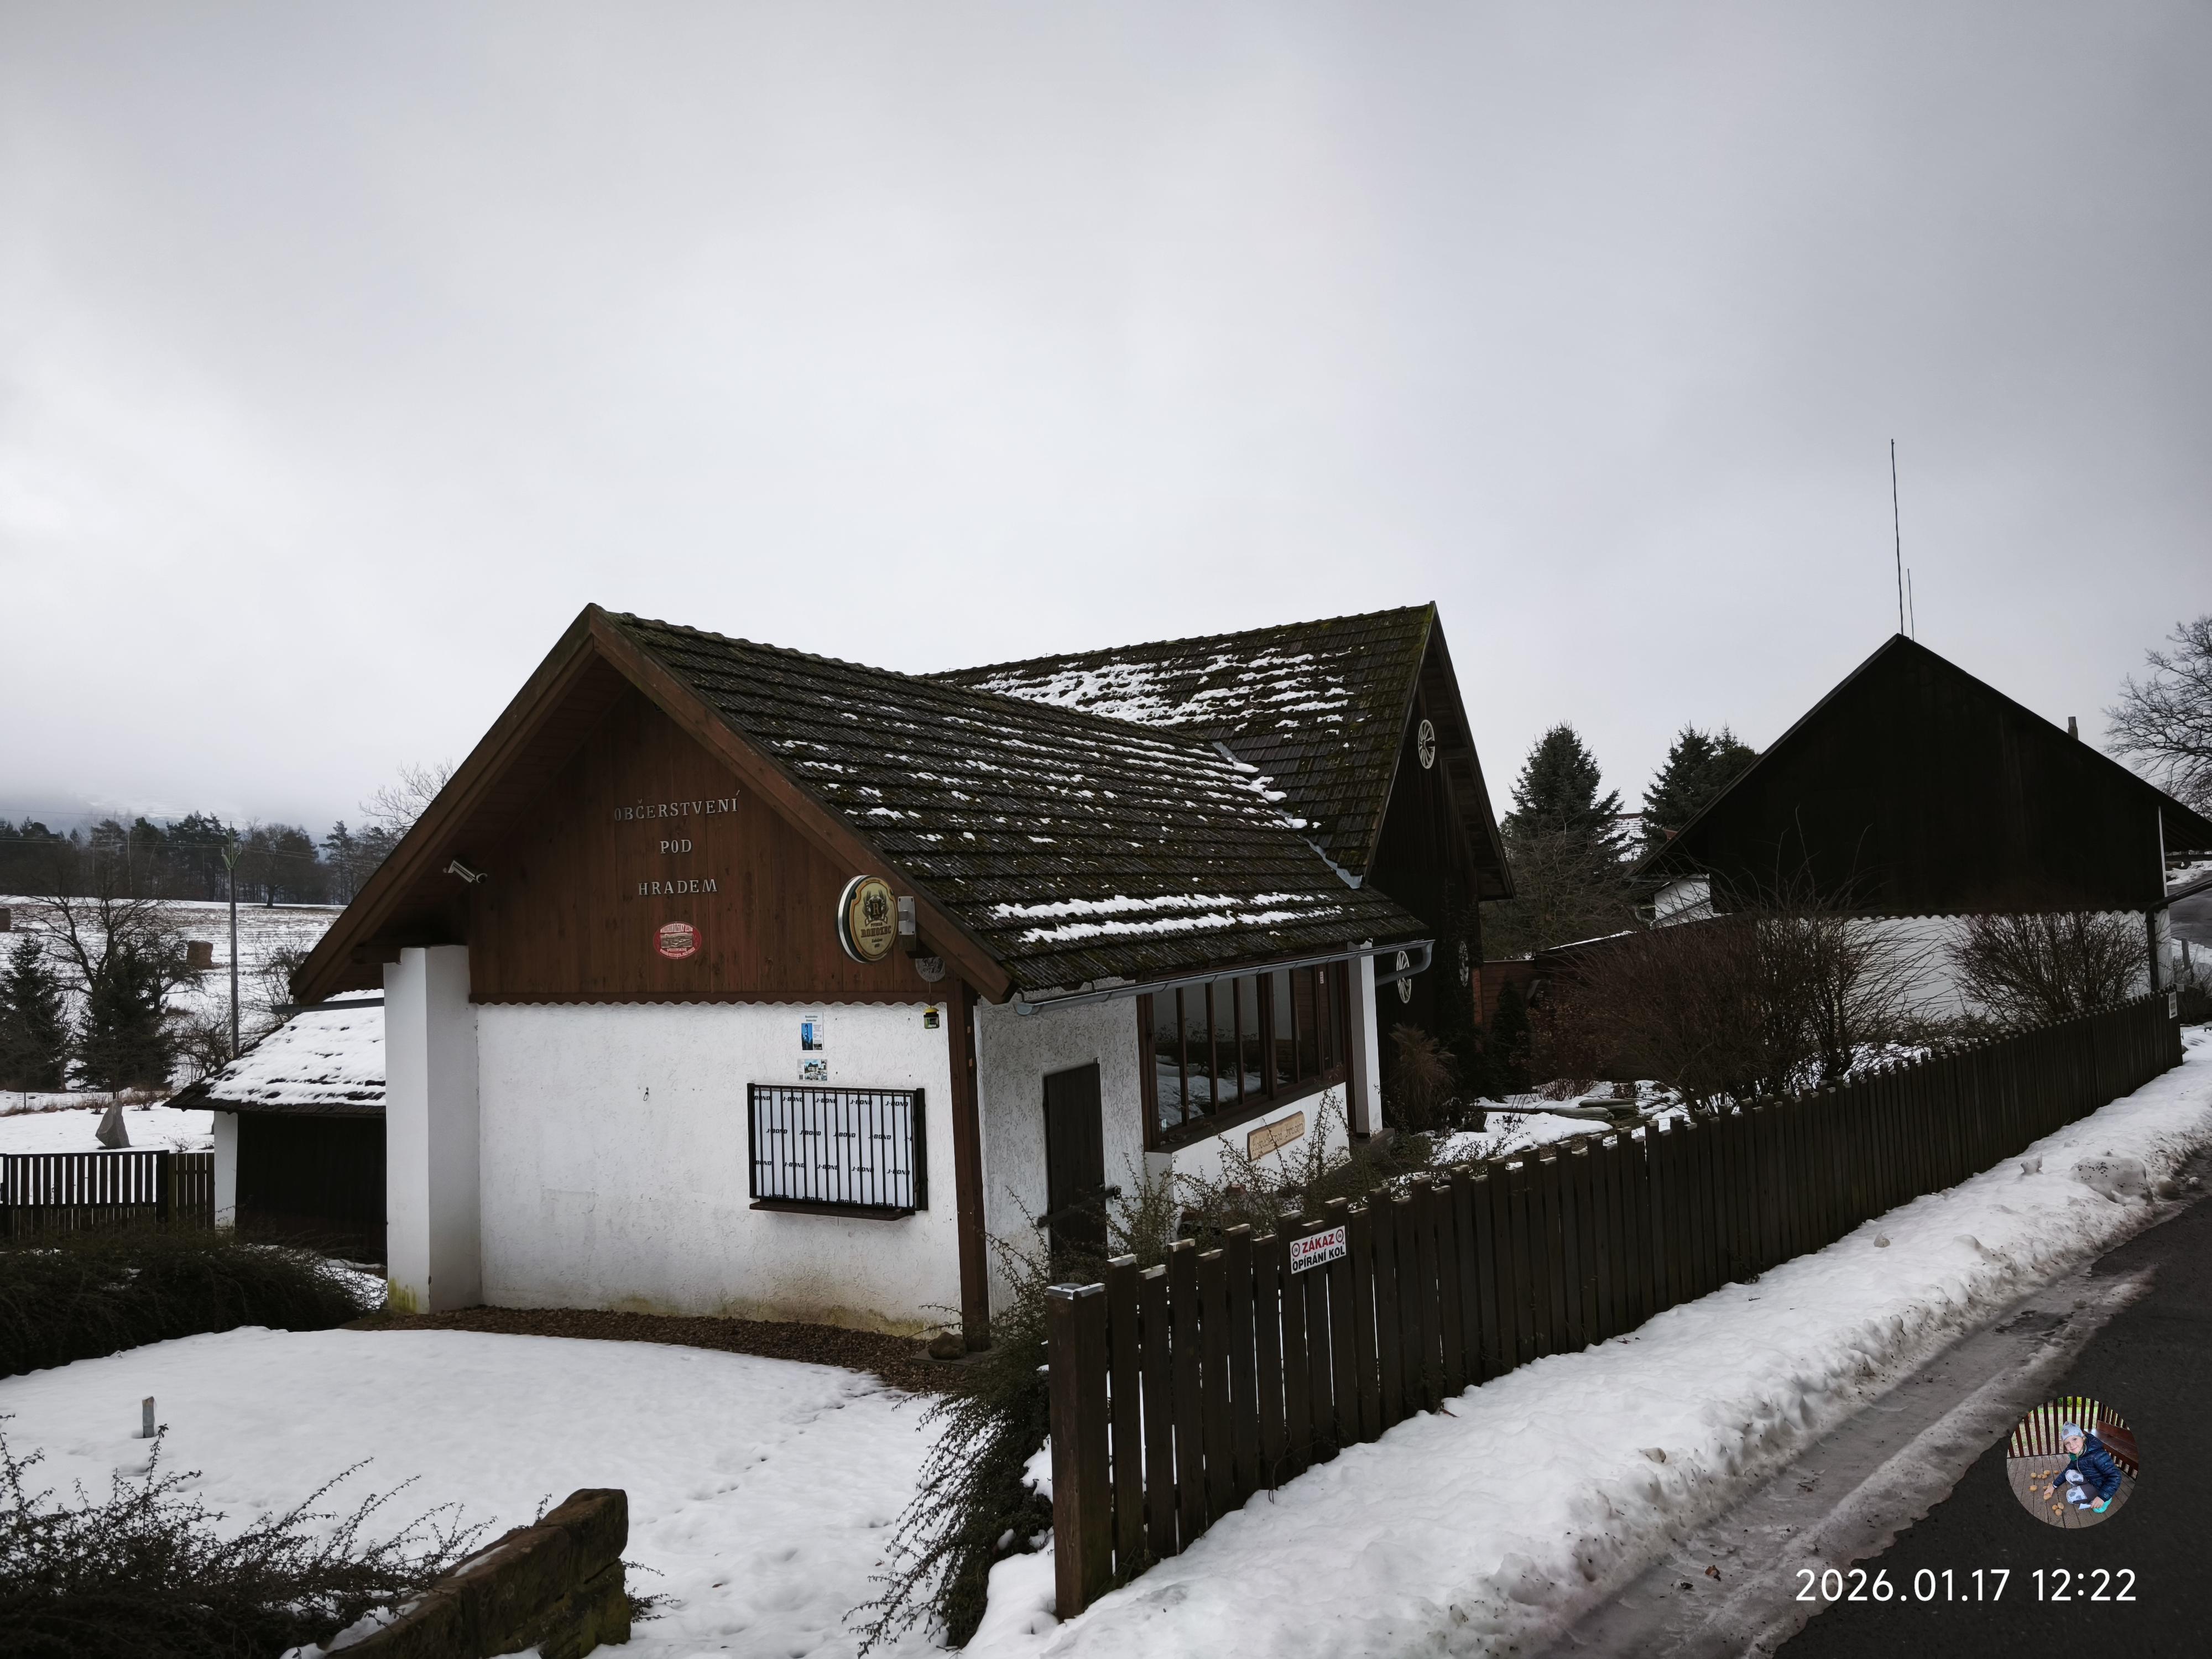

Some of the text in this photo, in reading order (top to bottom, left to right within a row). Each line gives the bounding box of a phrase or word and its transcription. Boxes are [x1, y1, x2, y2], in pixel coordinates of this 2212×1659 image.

[614, 789, 740, 821] OBČERSTVENÍ
[660, 839, 692, 854] POD
[638, 878, 717, 895] HRADEM
[872, 902, 880, 915] R
[861, 925, 891, 938] ROHOZEC
[1302, 1233, 1334, 1254] ZÁKAZ
[1292, 1245, 1345, 1271] OPÍRÁNÍ KOL
